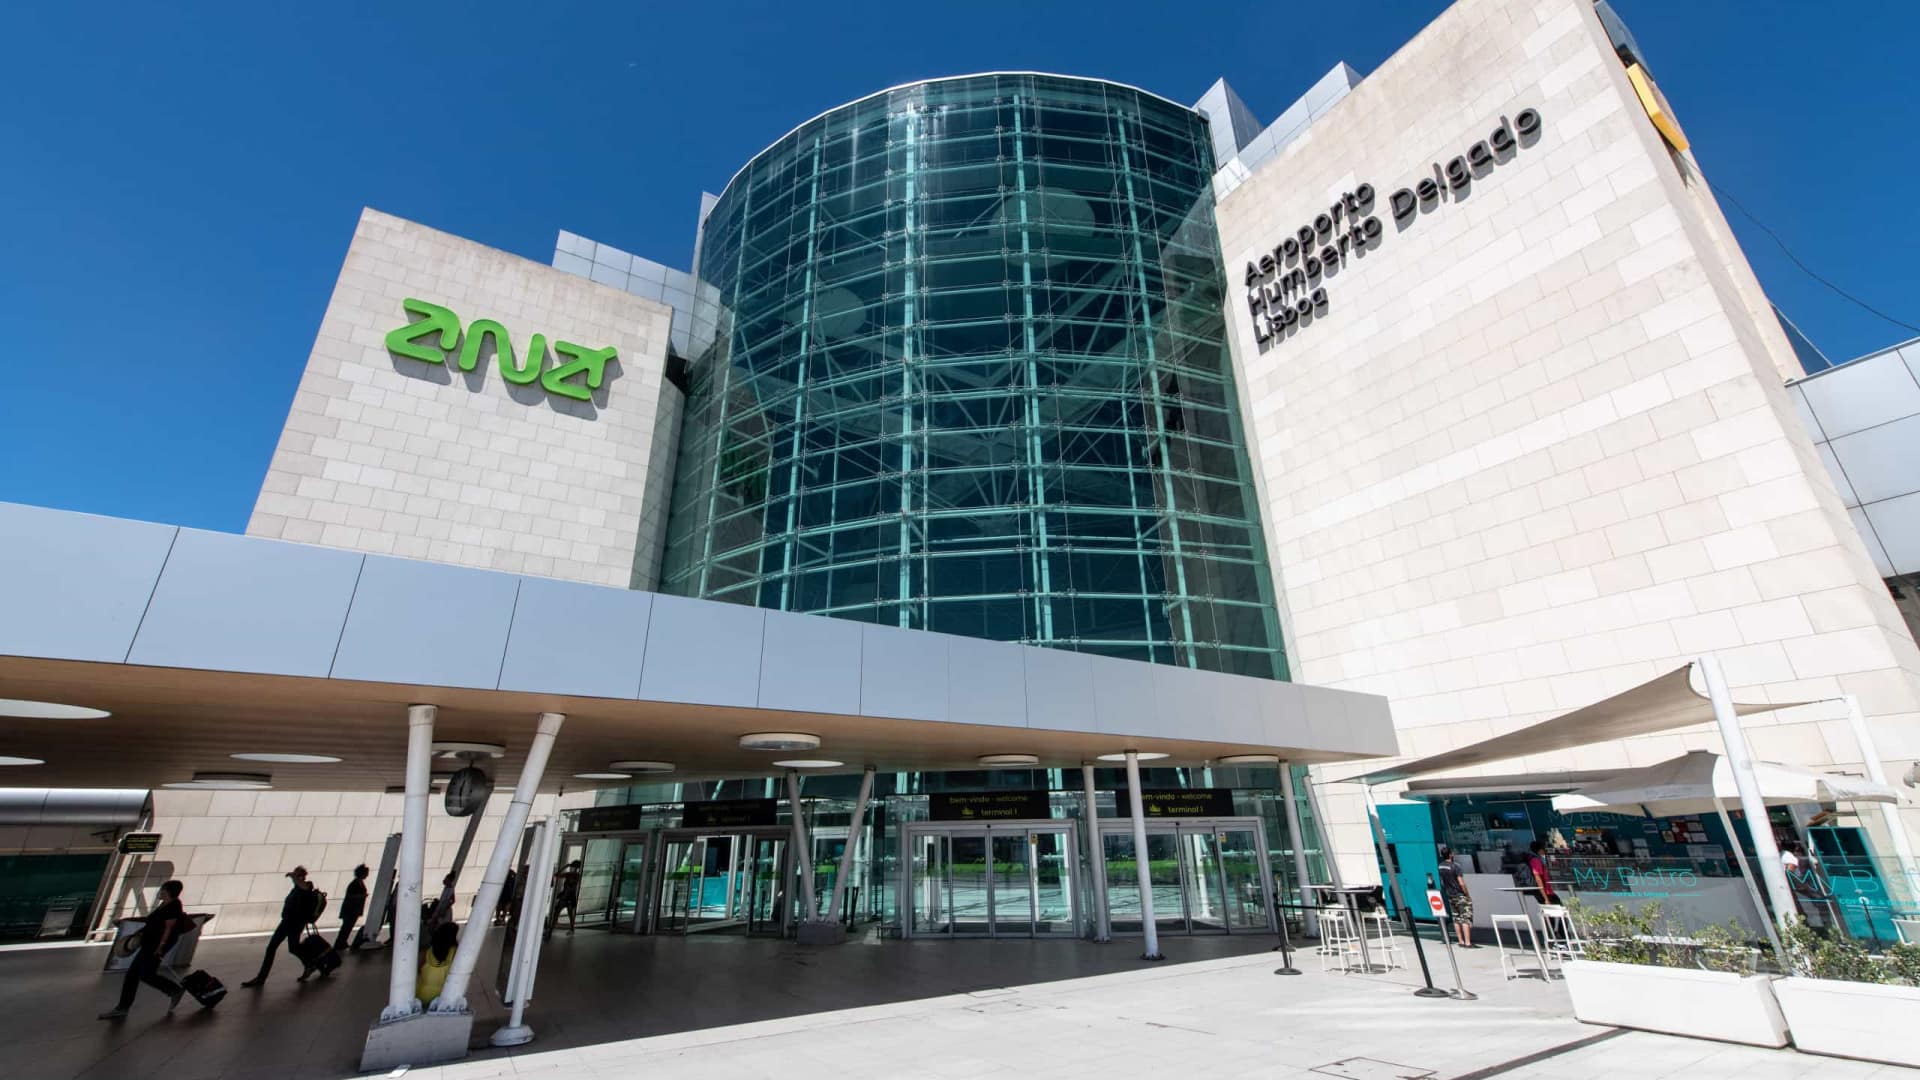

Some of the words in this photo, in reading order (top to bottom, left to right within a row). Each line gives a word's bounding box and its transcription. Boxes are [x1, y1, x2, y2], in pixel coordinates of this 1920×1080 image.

[1247, 216, 1382, 317] Humberto
[1389, 108, 1542, 220] Delgado
[1245, 183, 1375, 287] Aeroporto
[1254, 287, 1330, 345] Lisboa
[981, 807, 1013, 816] terminal
[1168, 805, 1199, 814] terminal
[1573, 867, 1610, 890] My
[1617, 866, 1697, 888] Bistro
[1785, 869, 1837, 896] My
